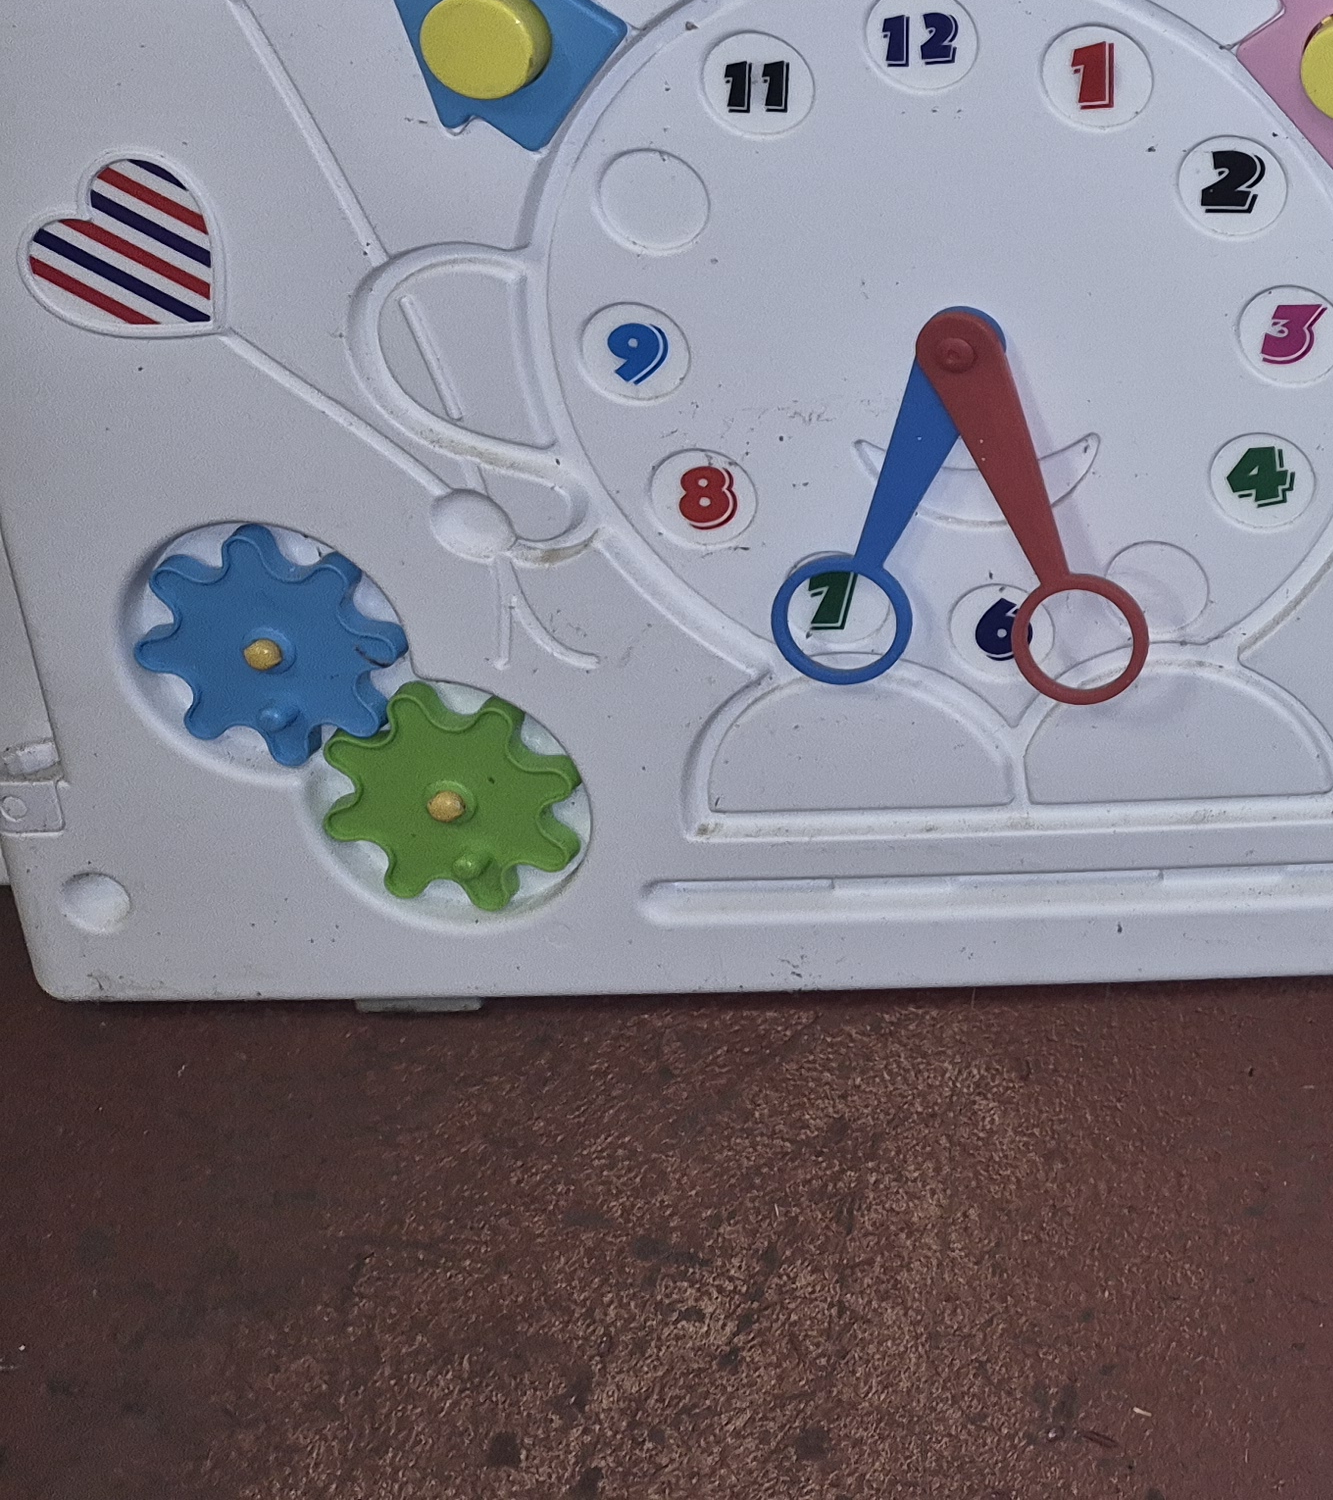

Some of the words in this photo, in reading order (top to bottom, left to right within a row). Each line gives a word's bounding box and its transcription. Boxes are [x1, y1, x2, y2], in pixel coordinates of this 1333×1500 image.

[882, 11, 958, 67] 12
[723, 60, 789, 112] 11
[1071, 41, 1115, 109] 1
[1201, 150, 1265, 214] 2
[607, 322, 668, 384] 9
[1260, 303, 1328, 364] 3
[678, 465, 737, 530] 8
[1226, 446, 1295, 508] 4
[975, 597, 1034, 661] 6
